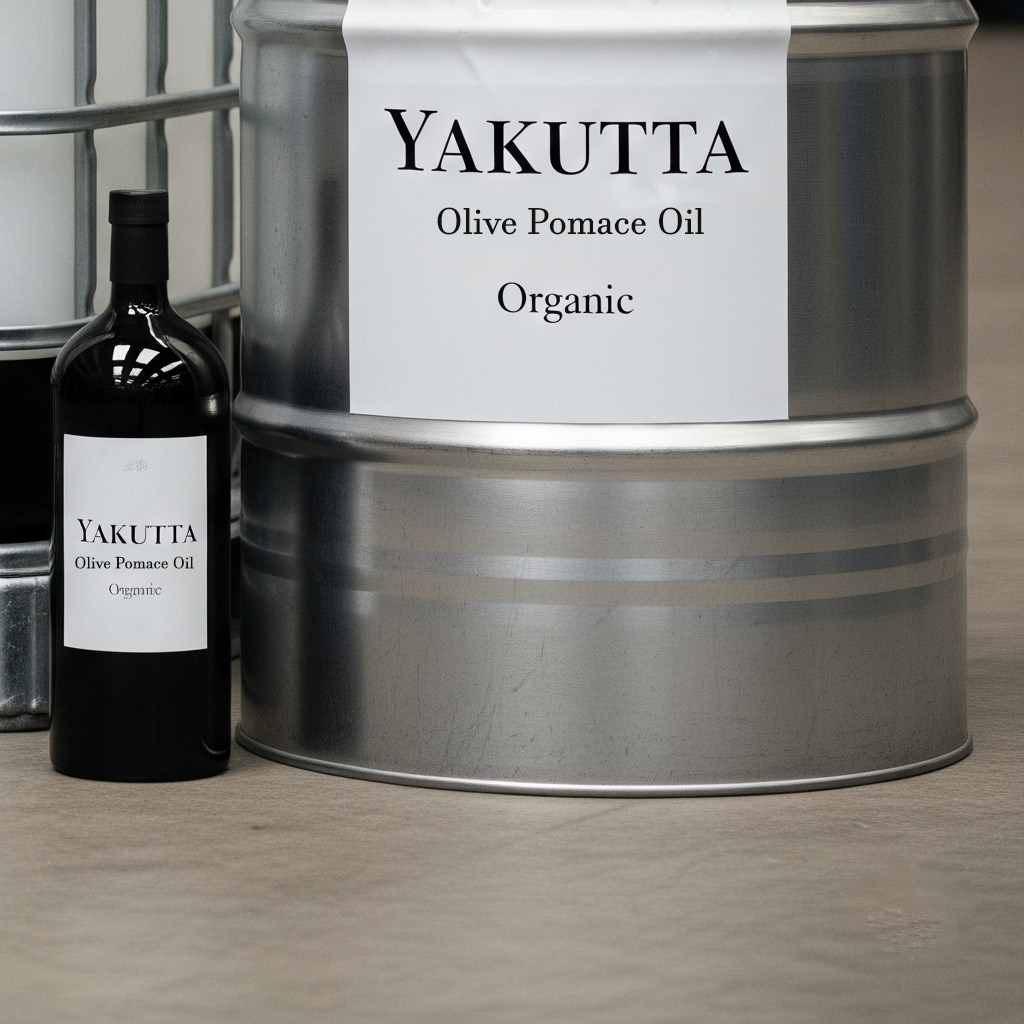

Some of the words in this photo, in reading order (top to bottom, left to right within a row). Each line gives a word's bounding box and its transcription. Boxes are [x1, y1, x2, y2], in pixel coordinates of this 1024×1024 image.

[384, 107, 750, 176] YAKUTTA
[436, 206, 517, 236] Olive
[527, 207, 647, 236] Pomace
[658, 207, 705, 236] Oil
[497, 281, 634, 324] Organic
[77, 518, 198, 545] YAKUTTA
[74, 555, 111, 570] Olive
[115, 556, 169, 570] Pomace
[173, 556, 195, 570] Oil
